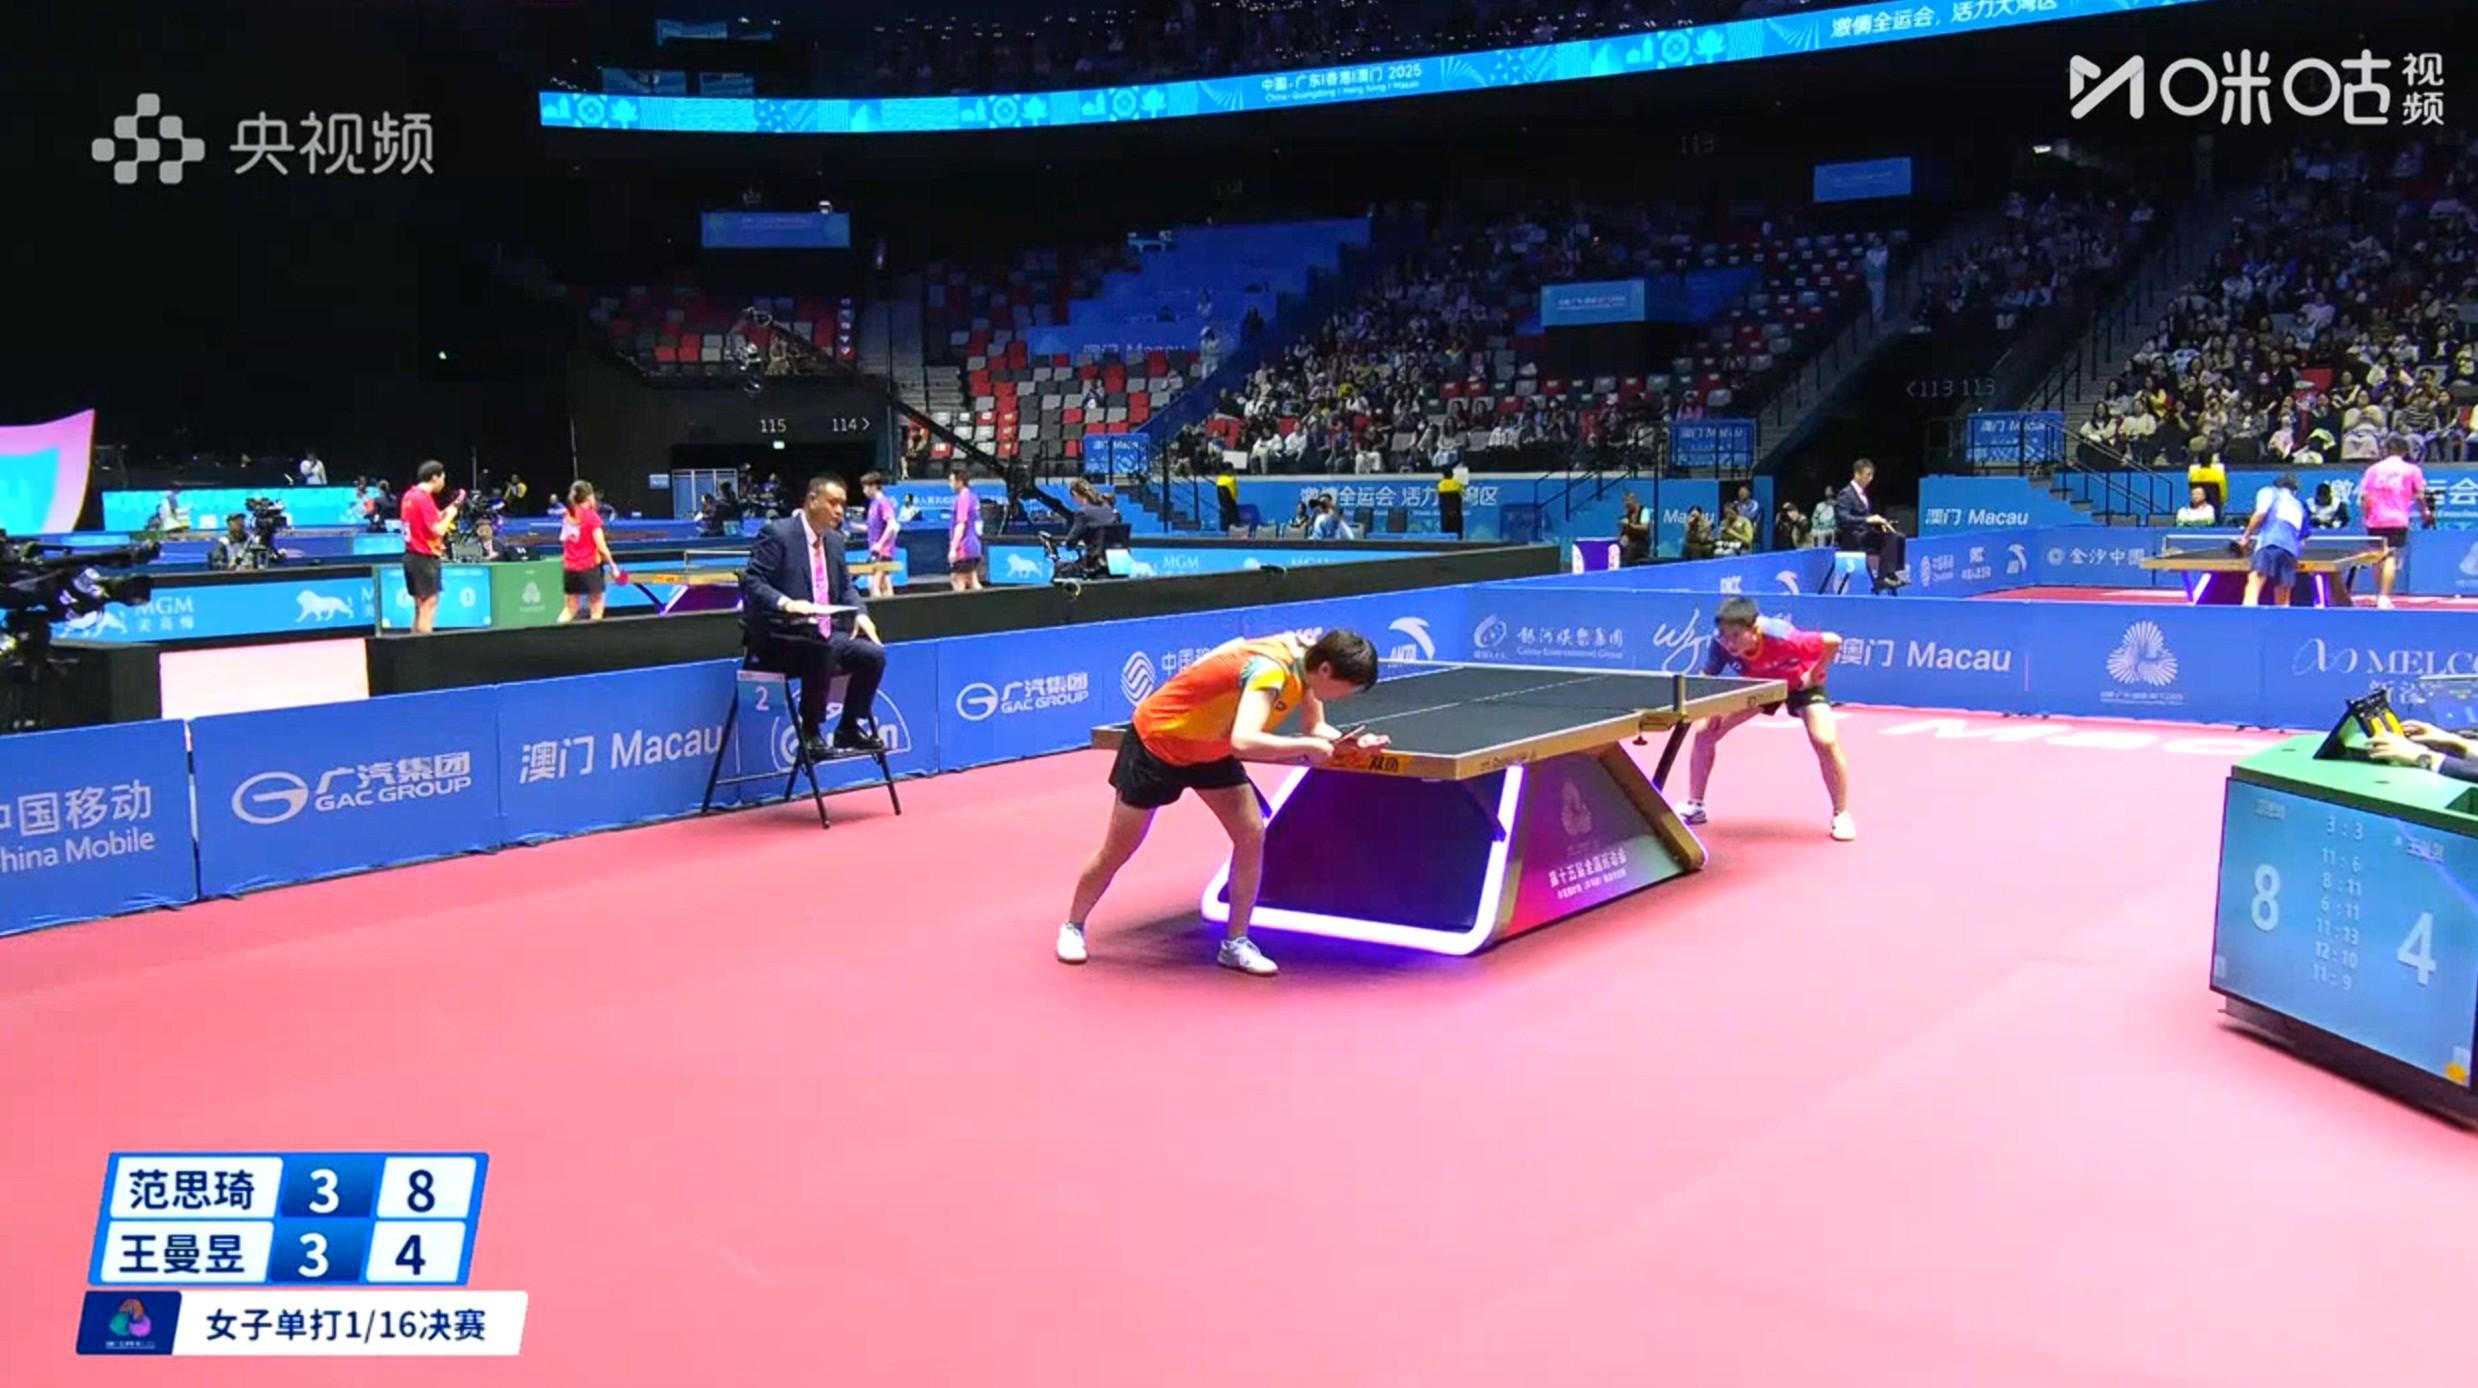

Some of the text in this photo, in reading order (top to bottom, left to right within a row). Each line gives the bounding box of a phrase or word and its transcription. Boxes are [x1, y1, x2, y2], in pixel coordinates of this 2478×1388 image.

[1388, 63, 1423, 80] 2025
[760, 418, 787, 433] 115
[832, 417, 857, 432] 114
[1401, 486, 1499, 507] 活力湾区
[1926, 508, 2029, 525] 澳门 Macau
[1163, 555, 1199, 569] MGM
[136, 596, 194, 615] MGM
[1834, 637, 2012, 672] 澳门 Macau
[2365, 650, 2478, 675] MELC
[755, 685, 771, 712] 2
[1001, 690, 1089, 714] GAC GROUP
[520, 734, 596, 784] 澳门
[610, 725, 723, 771] Macau
[315, 751, 471, 795] 广汽集团
[0, 779, 152, 836] 国移动
[315, 776, 472, 813] GAC GROUP
[0, 831, 156, 874] hina Mobile
[2251, 863, 2281, 932] 8
[2397, 911, 2437, 988] 4
